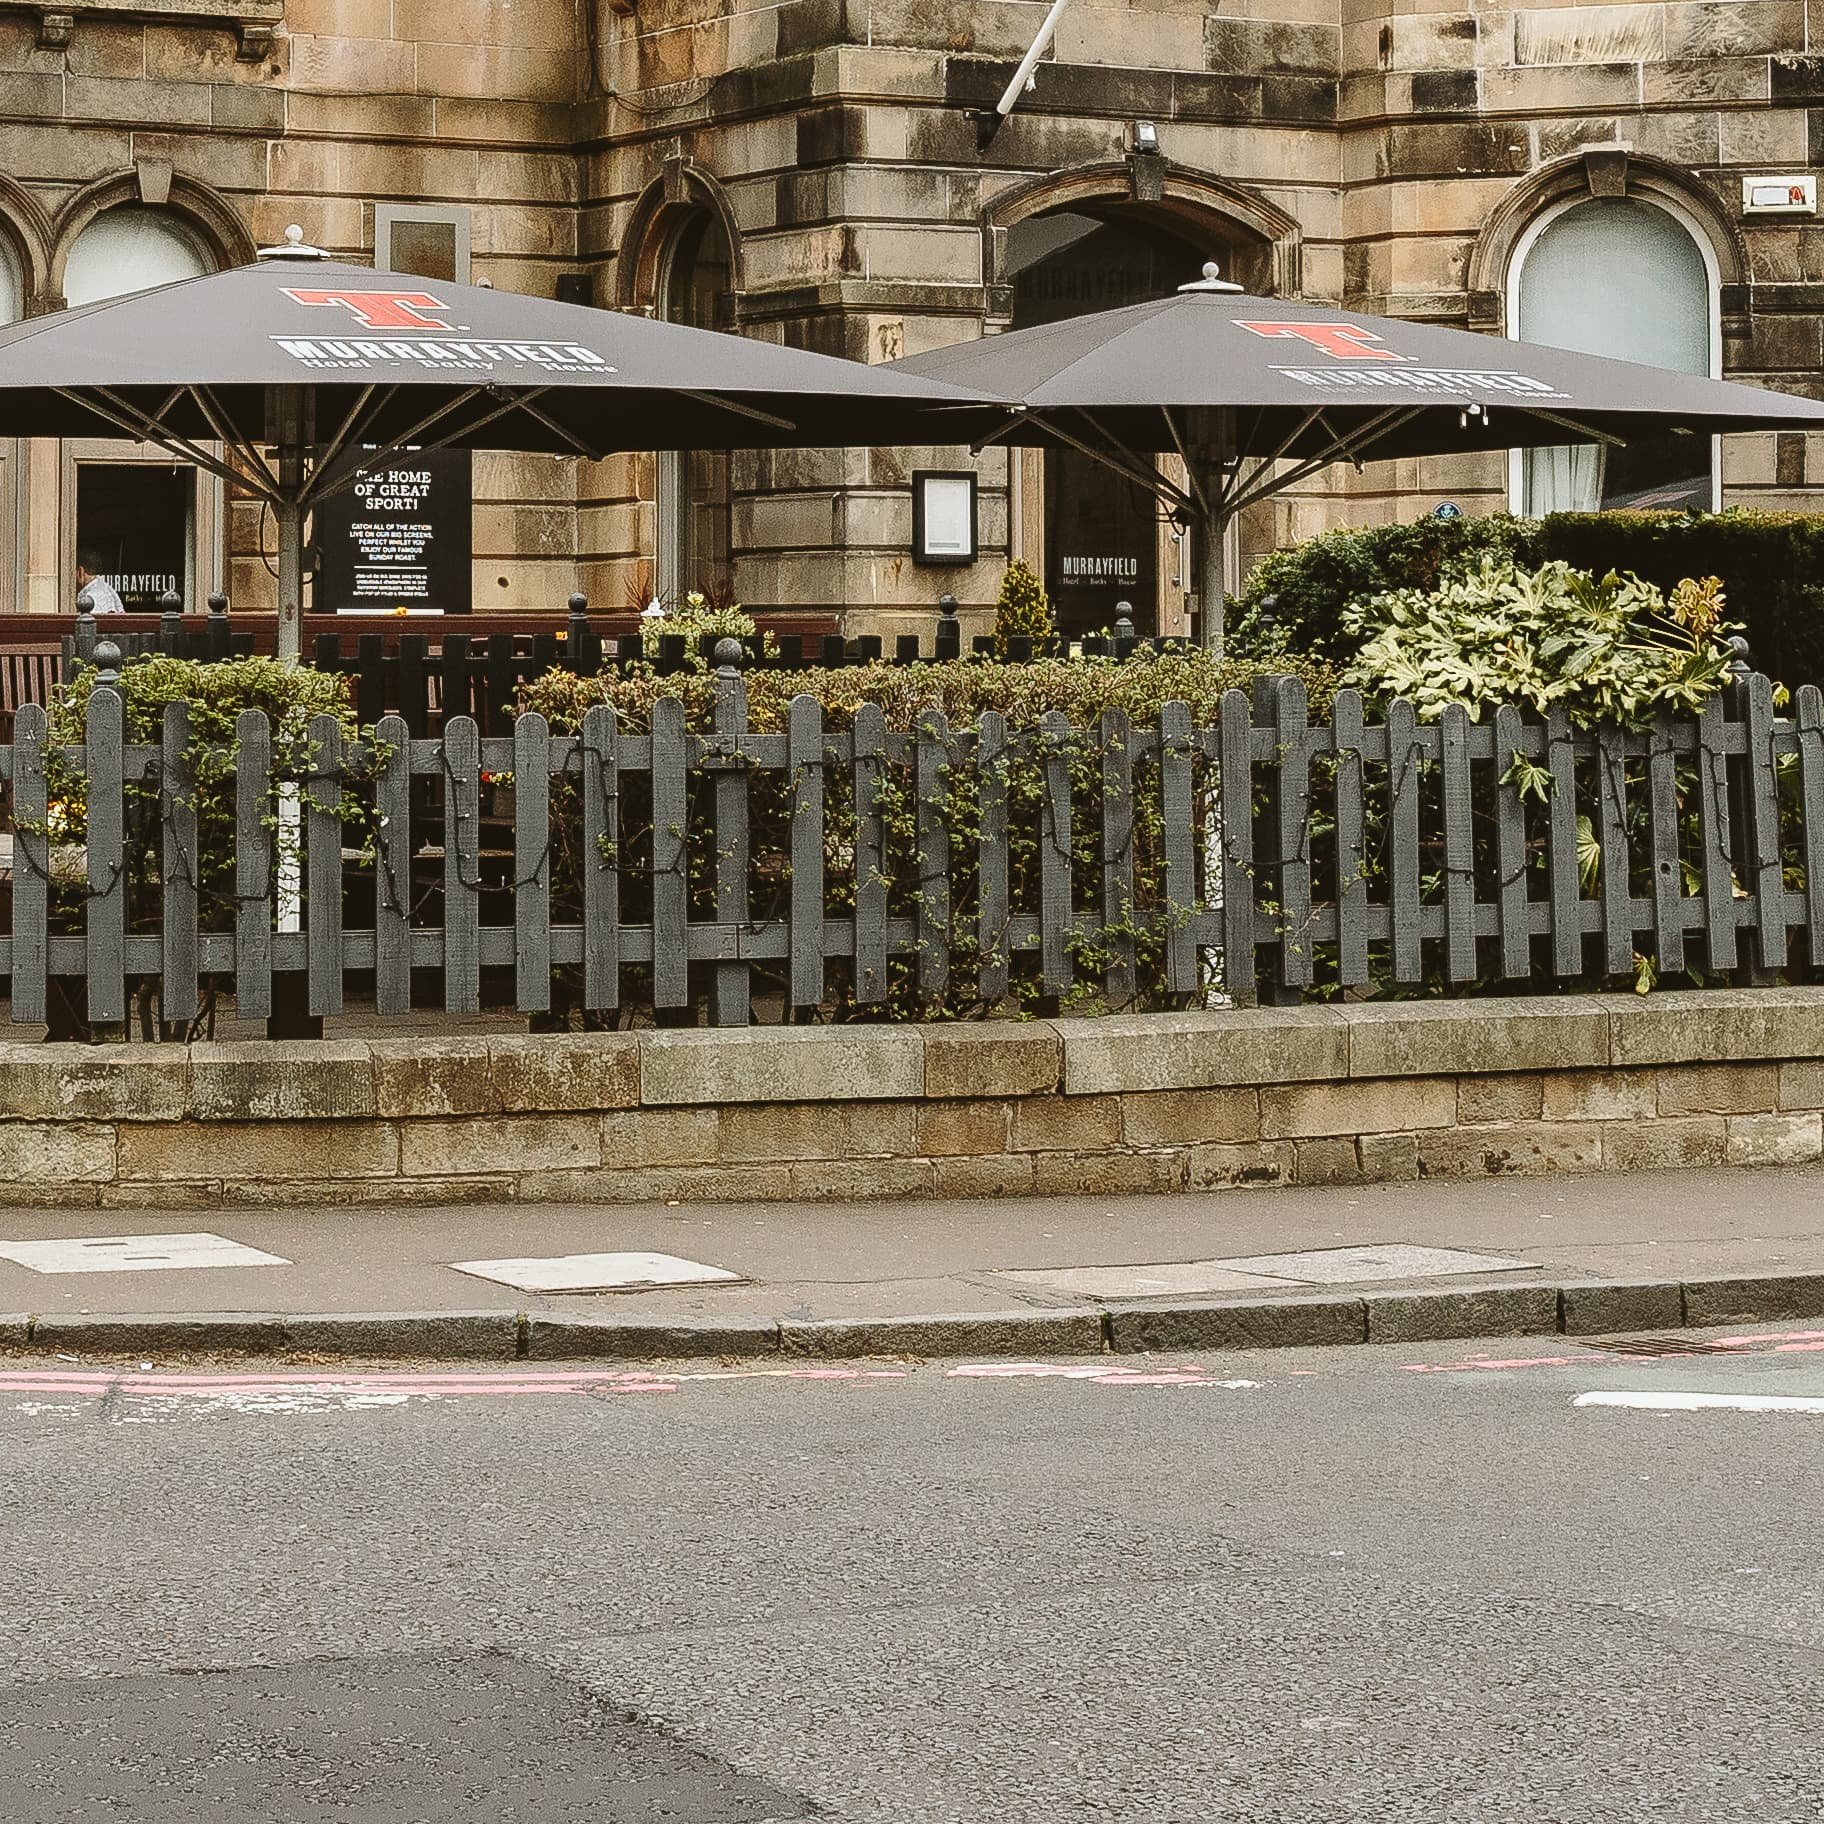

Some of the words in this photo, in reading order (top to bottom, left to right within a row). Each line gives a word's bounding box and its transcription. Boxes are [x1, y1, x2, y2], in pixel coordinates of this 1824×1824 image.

[277, 341, 606, 365] MURRAYFIELD
[300, 358, 372, 369] Hotel
[417, 360, 495, 371] Bothy
[537, 362, 619, 374] House
[388, 471, 432, 483] HOME
[354, 484, 375, 496] OF
[379, 484, 430, 497] GREAT
[365, 498, 418, 510] SPORT!
[1062, 557, 1137, 575] MURRAYFIELD
[97, 574, 176, 592] URRAYFIELD
